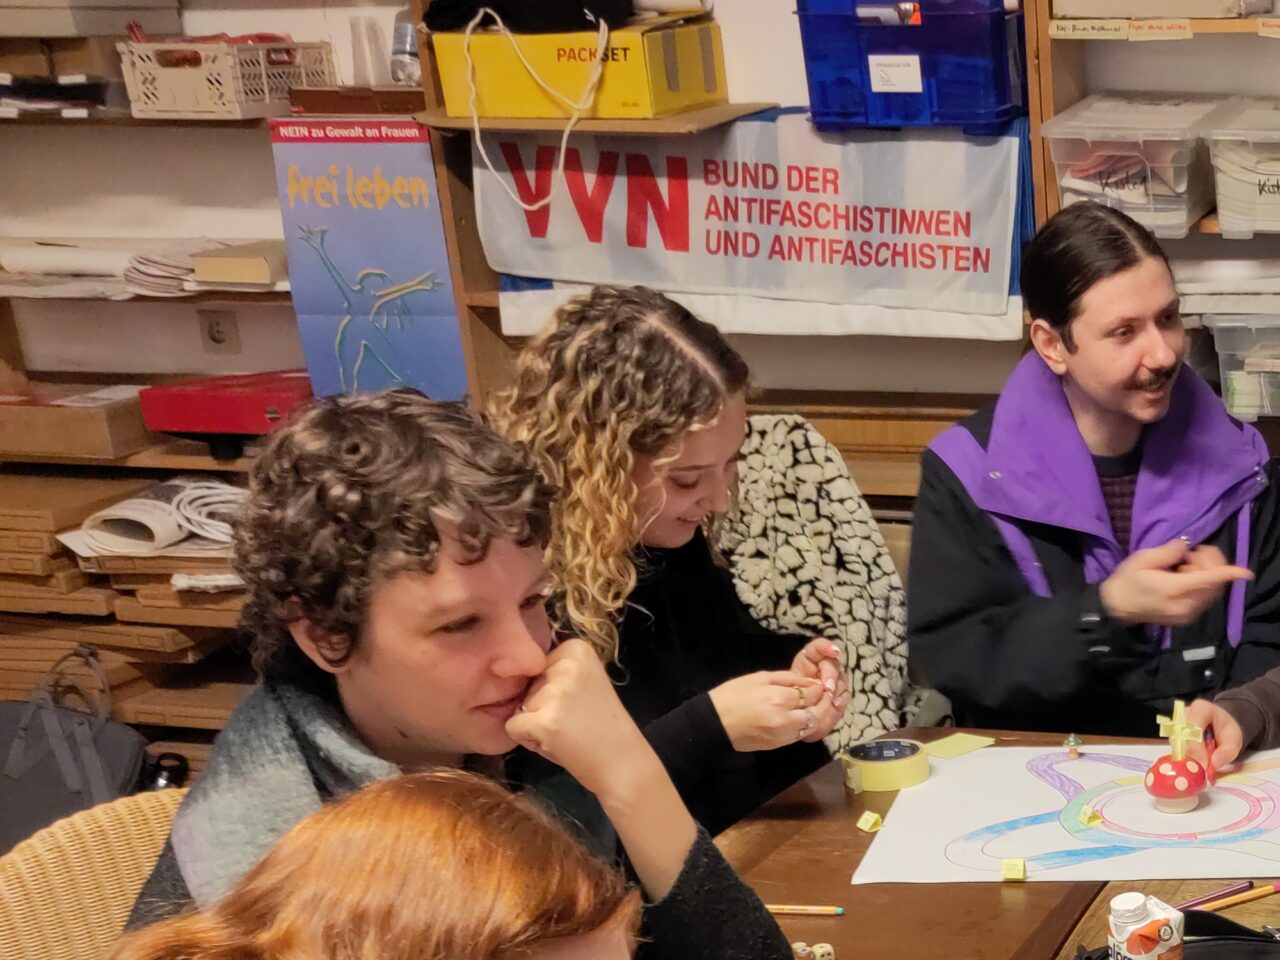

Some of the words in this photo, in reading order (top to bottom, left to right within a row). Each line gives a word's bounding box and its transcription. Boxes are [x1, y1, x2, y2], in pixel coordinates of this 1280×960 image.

[556, 47, 631, 62] PACKSET
[279, 126, 309, 138] NEIN
[311, 128, 325, 138] zu
[325, 126, 364, 138] Gewalt
[366, 127, 380, 138] an
[381, 126, 420, 138] Frauen
[285, 162, 340, 209] frei
[345, 163, 430, 212] leben
[500, 142, 691, 253] VVN
[703, 159, 780, 191] BUND
[786, 165, 840, 196] DER
[704, 196, 973, 239] ANTIFASCHISTINNEN
[704, 230, 761, 259] UND
[767, 234, 991, 274] ANTIFASCHISTEN
